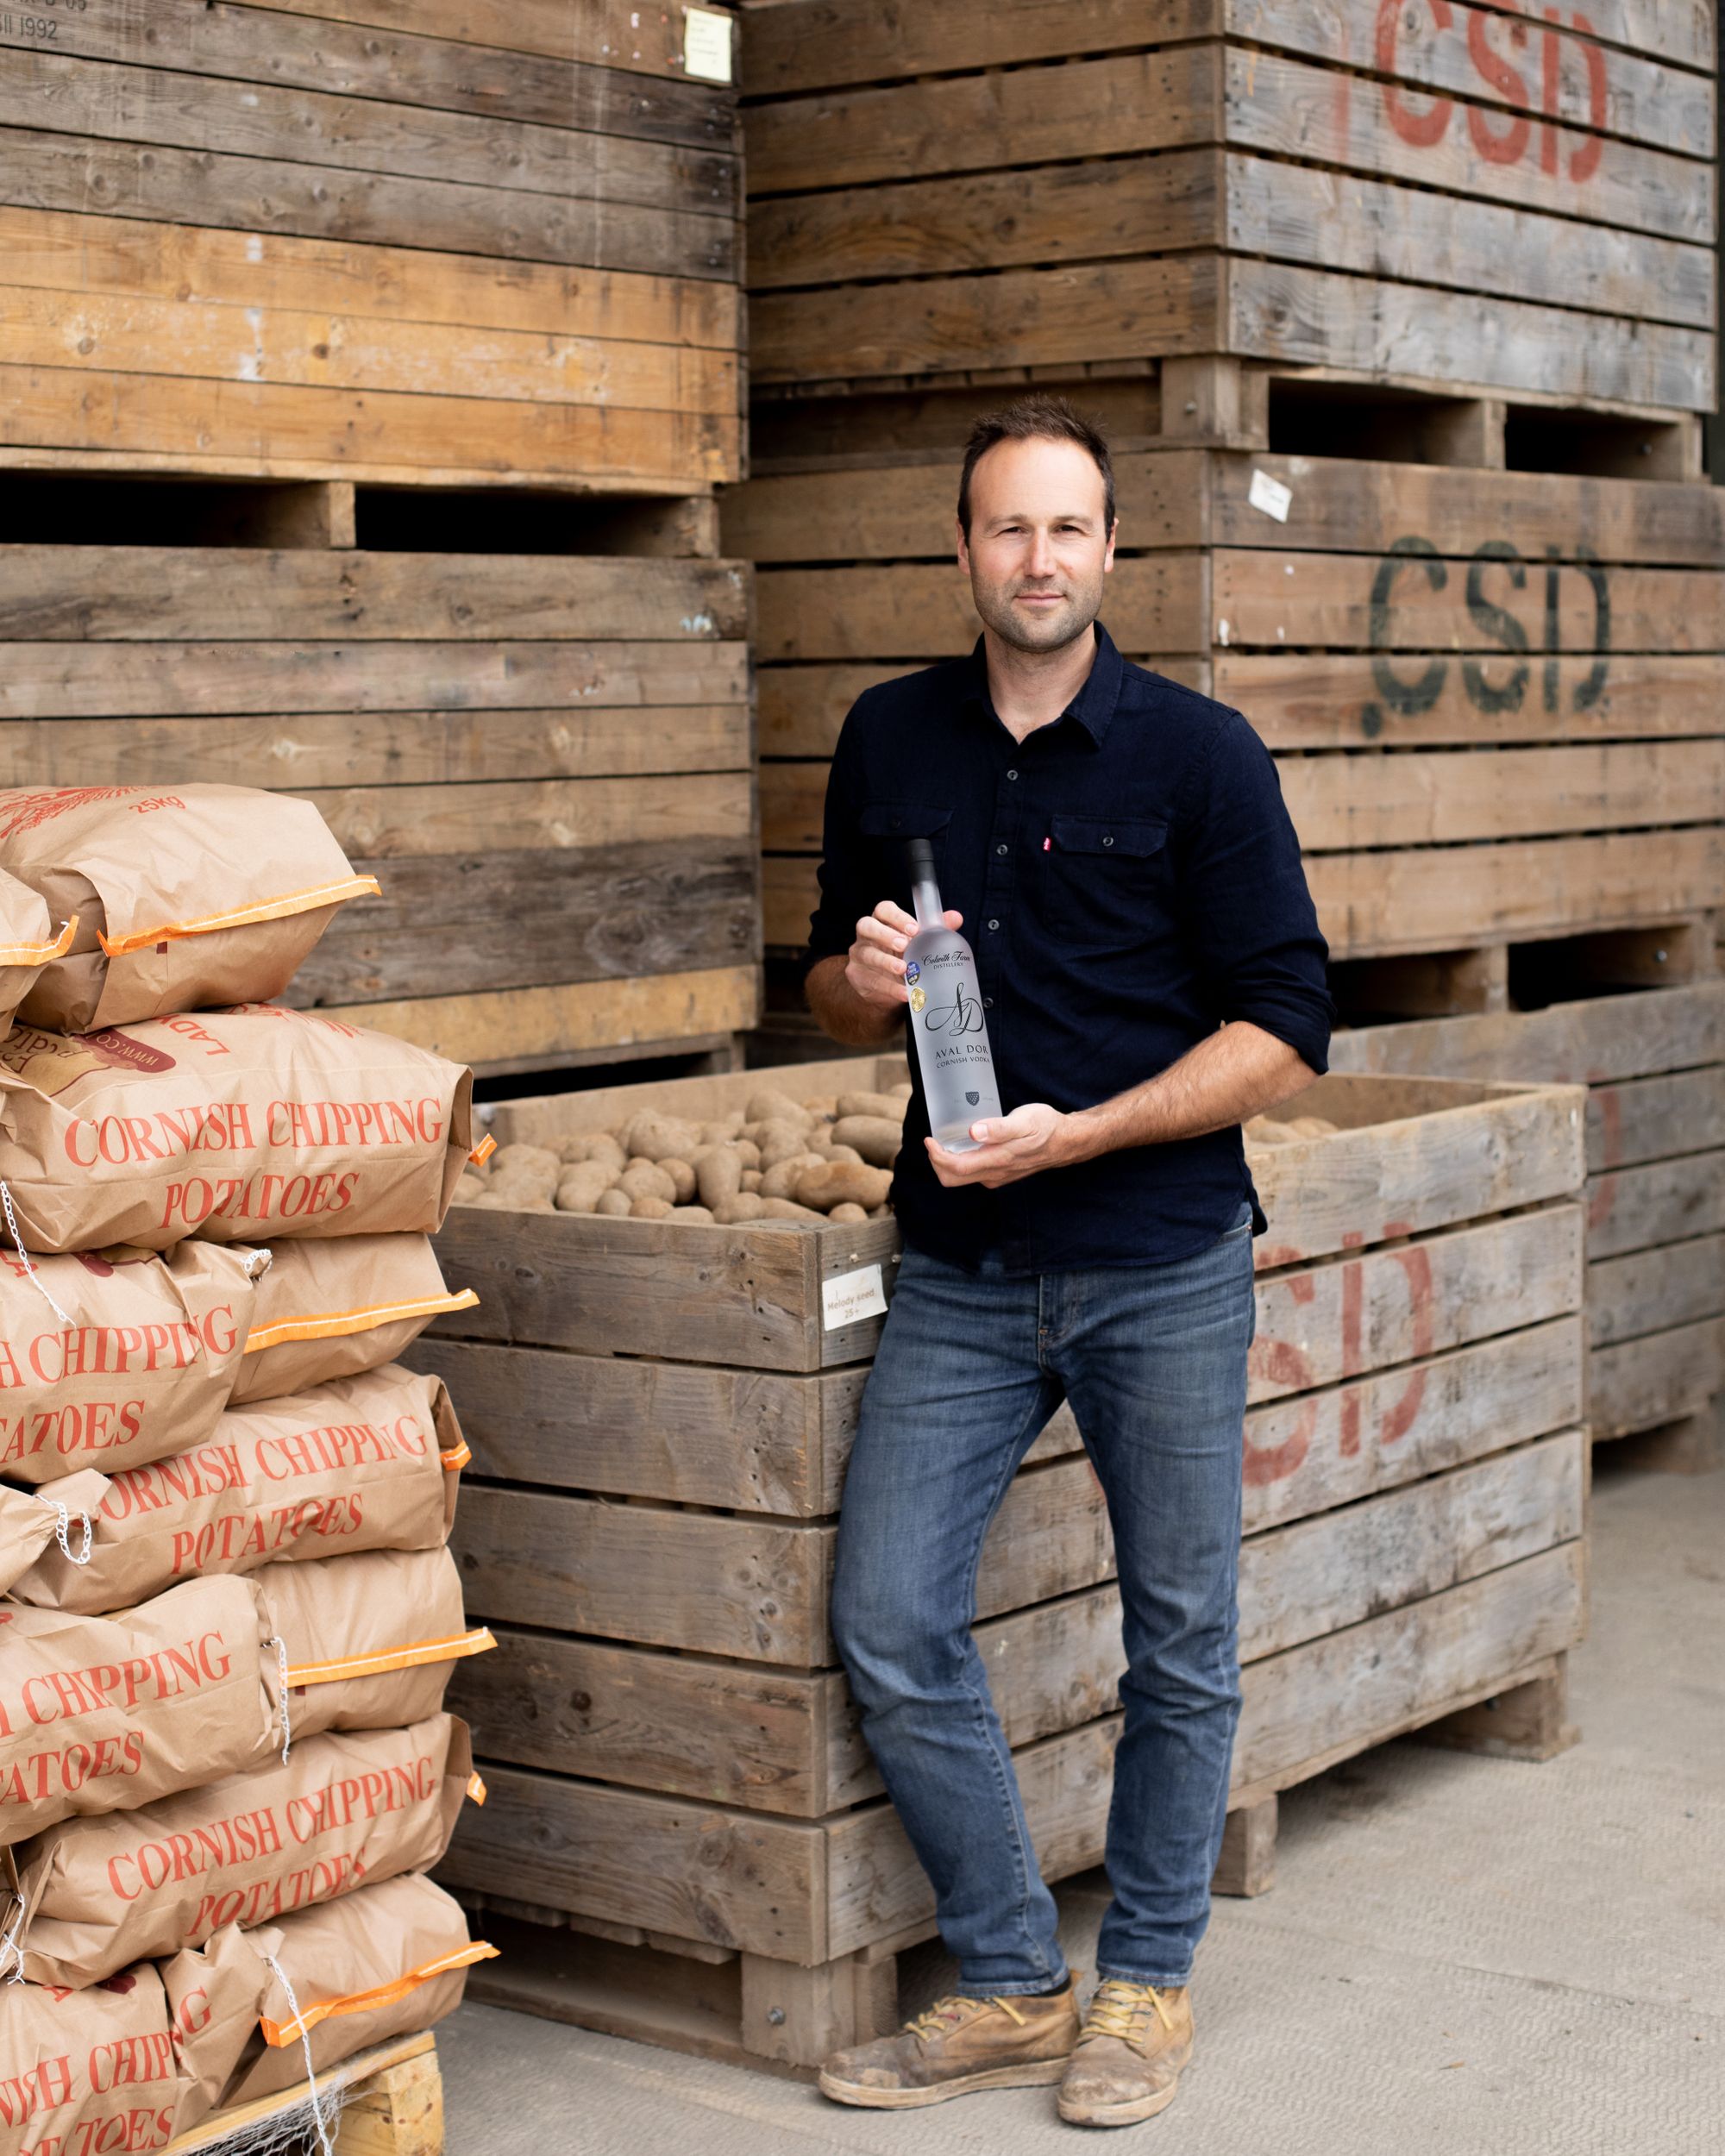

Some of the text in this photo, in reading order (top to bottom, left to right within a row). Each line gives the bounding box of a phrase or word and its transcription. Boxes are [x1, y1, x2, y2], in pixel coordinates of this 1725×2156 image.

[20, 16, 58, 41] 1992
[1376, 0, 1607, 184] CSD
[1369, 535, 1610, 718] CSD
[129, 795, 186, 814] 25kg
[933, 962, 964, 970] DISTILLERY
[935, 1044, 988, 1060] AVAL DOR
[936, 1056, 968, 1069] CORNISH
[65, 1098, 442, 1168] CORNISH CHIPPING
[158, 1172, 360, 1230] POTATOES
[29, 1305, 238, 1384] CHIPPING
[1243, 1221, 1433, 1489] SD
[71, 1414, 429, 1528] ORNISH CHIPPING
[170, 1493, 363, 1576] POTATOES
[21, 1630, 231, 1726] CHIPPING
[0, 1731, 145, 1805] ATOES
[107, 1756, 436, 1901] CORNISH CHIPPING
